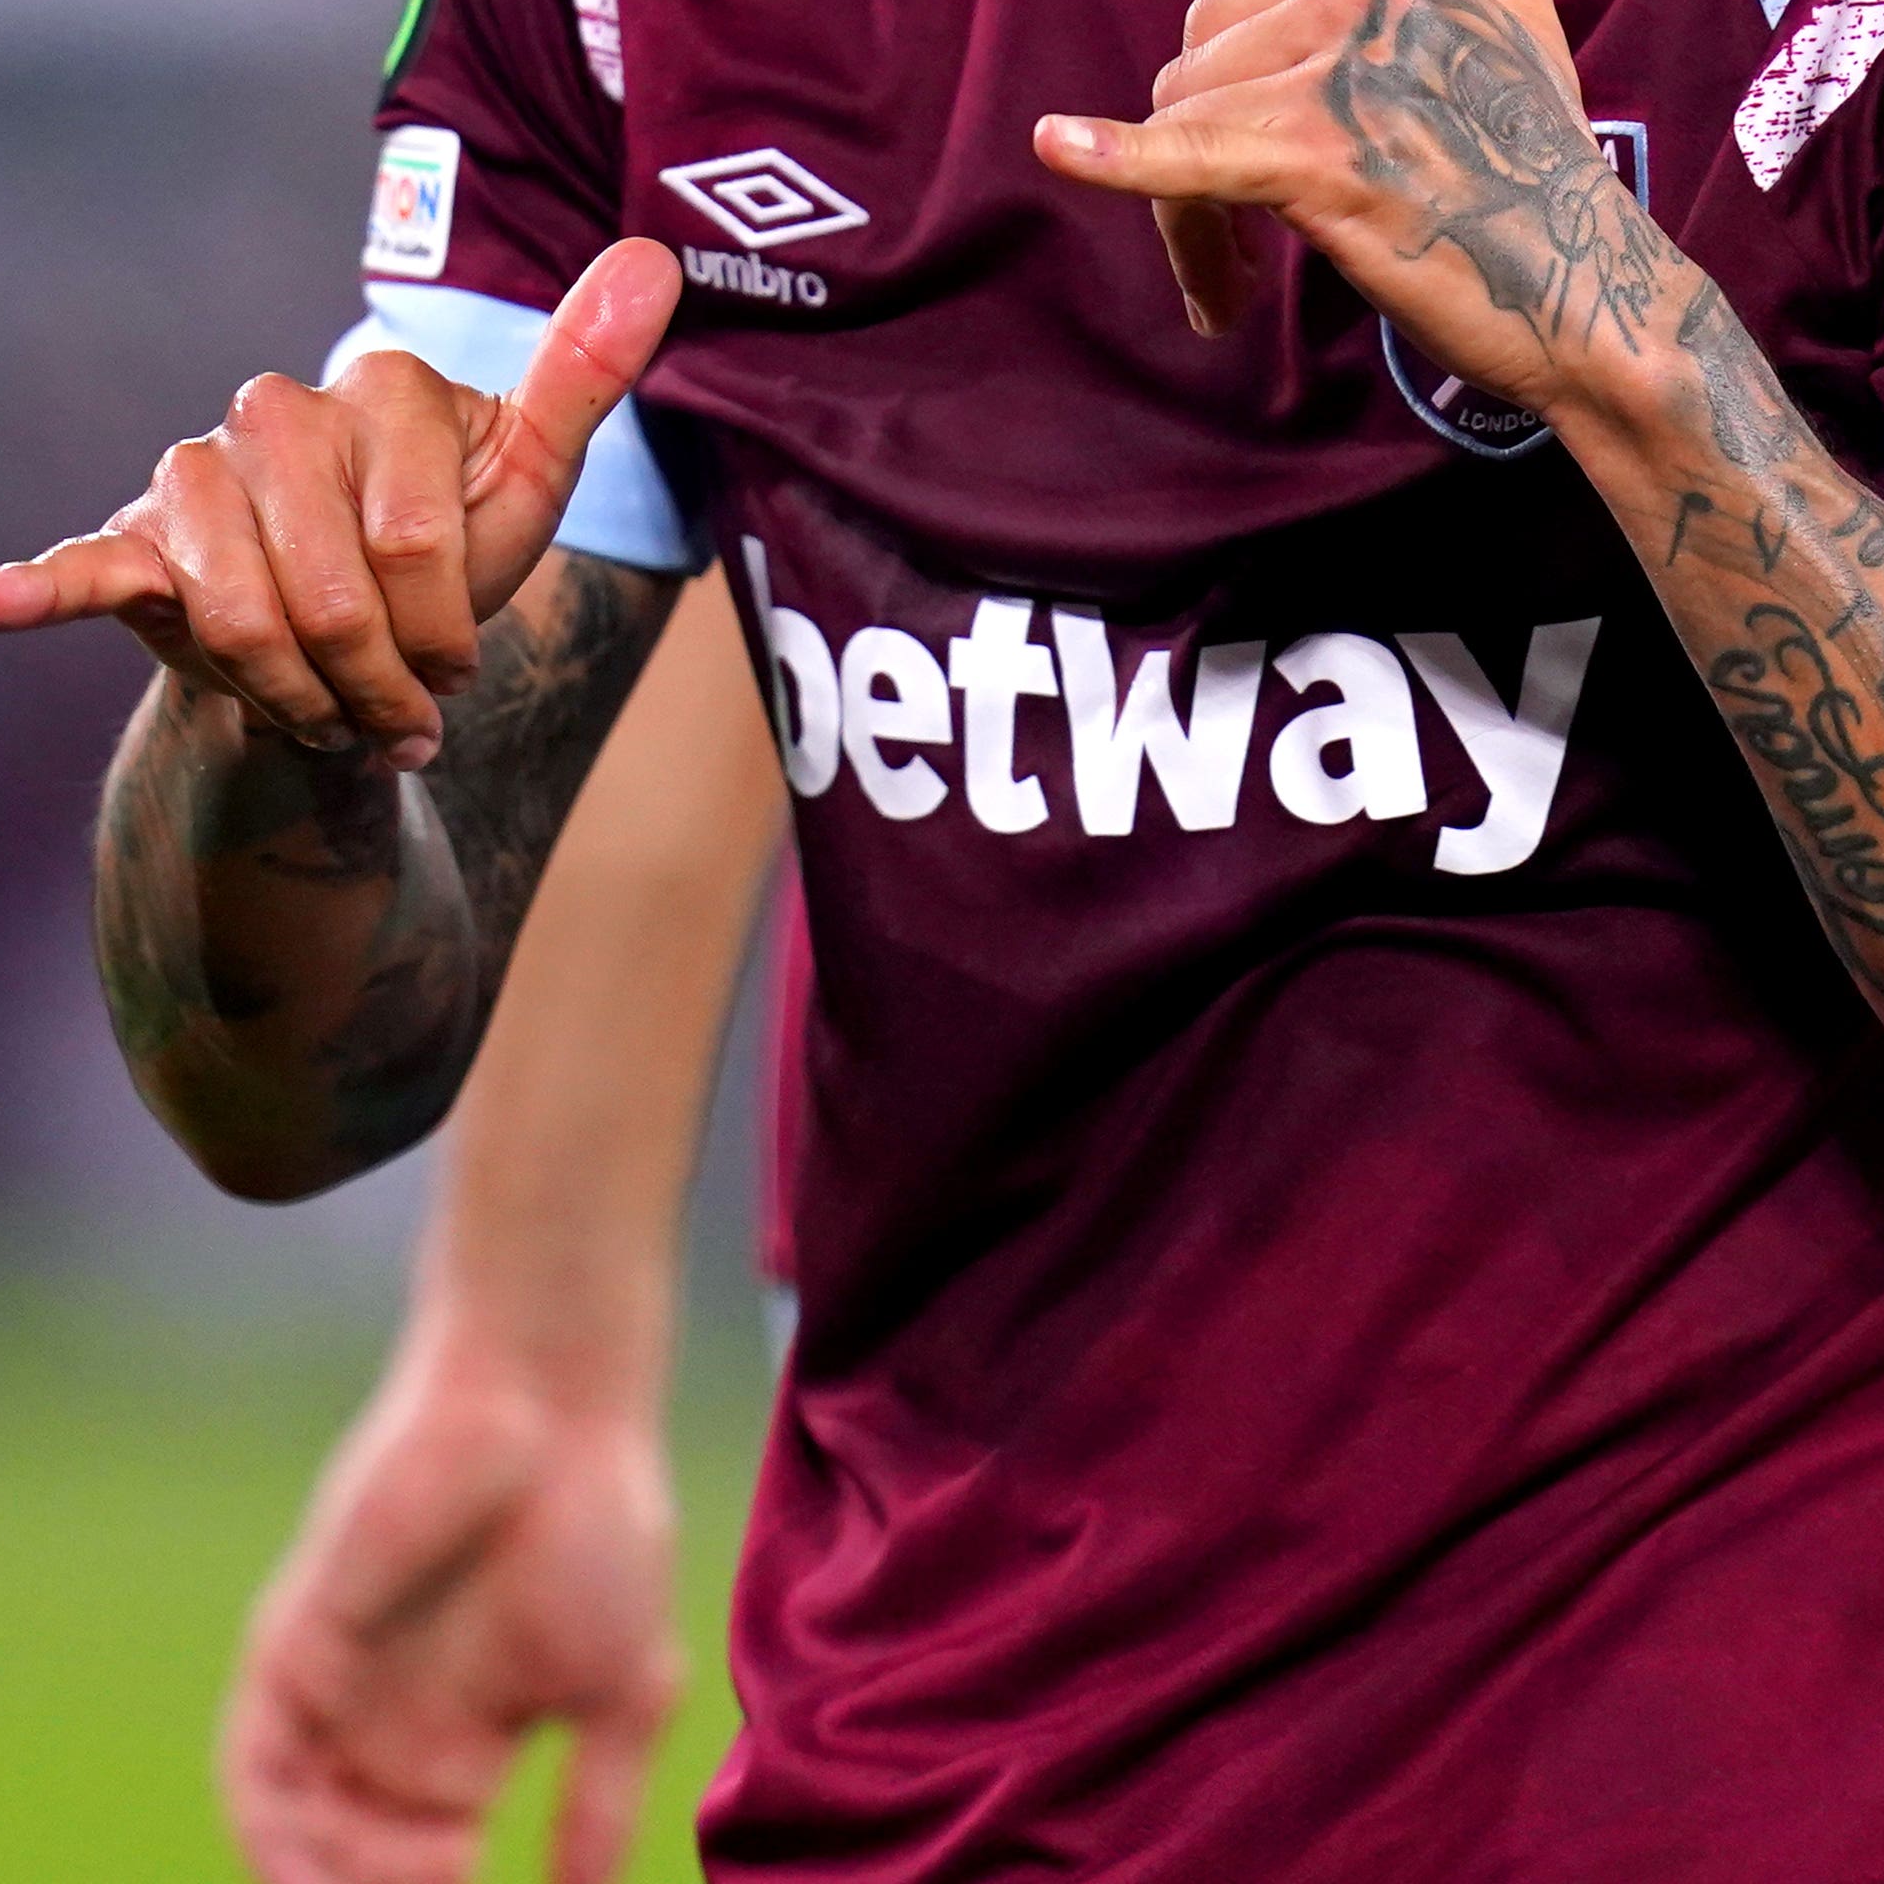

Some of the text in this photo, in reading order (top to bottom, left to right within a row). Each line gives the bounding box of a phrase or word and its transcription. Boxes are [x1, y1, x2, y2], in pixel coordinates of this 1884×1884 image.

[682, 245, 829, 308] umbro
[1458, 407, 1544, 433] LONDO
[740, 533, 1602, 876] betway
